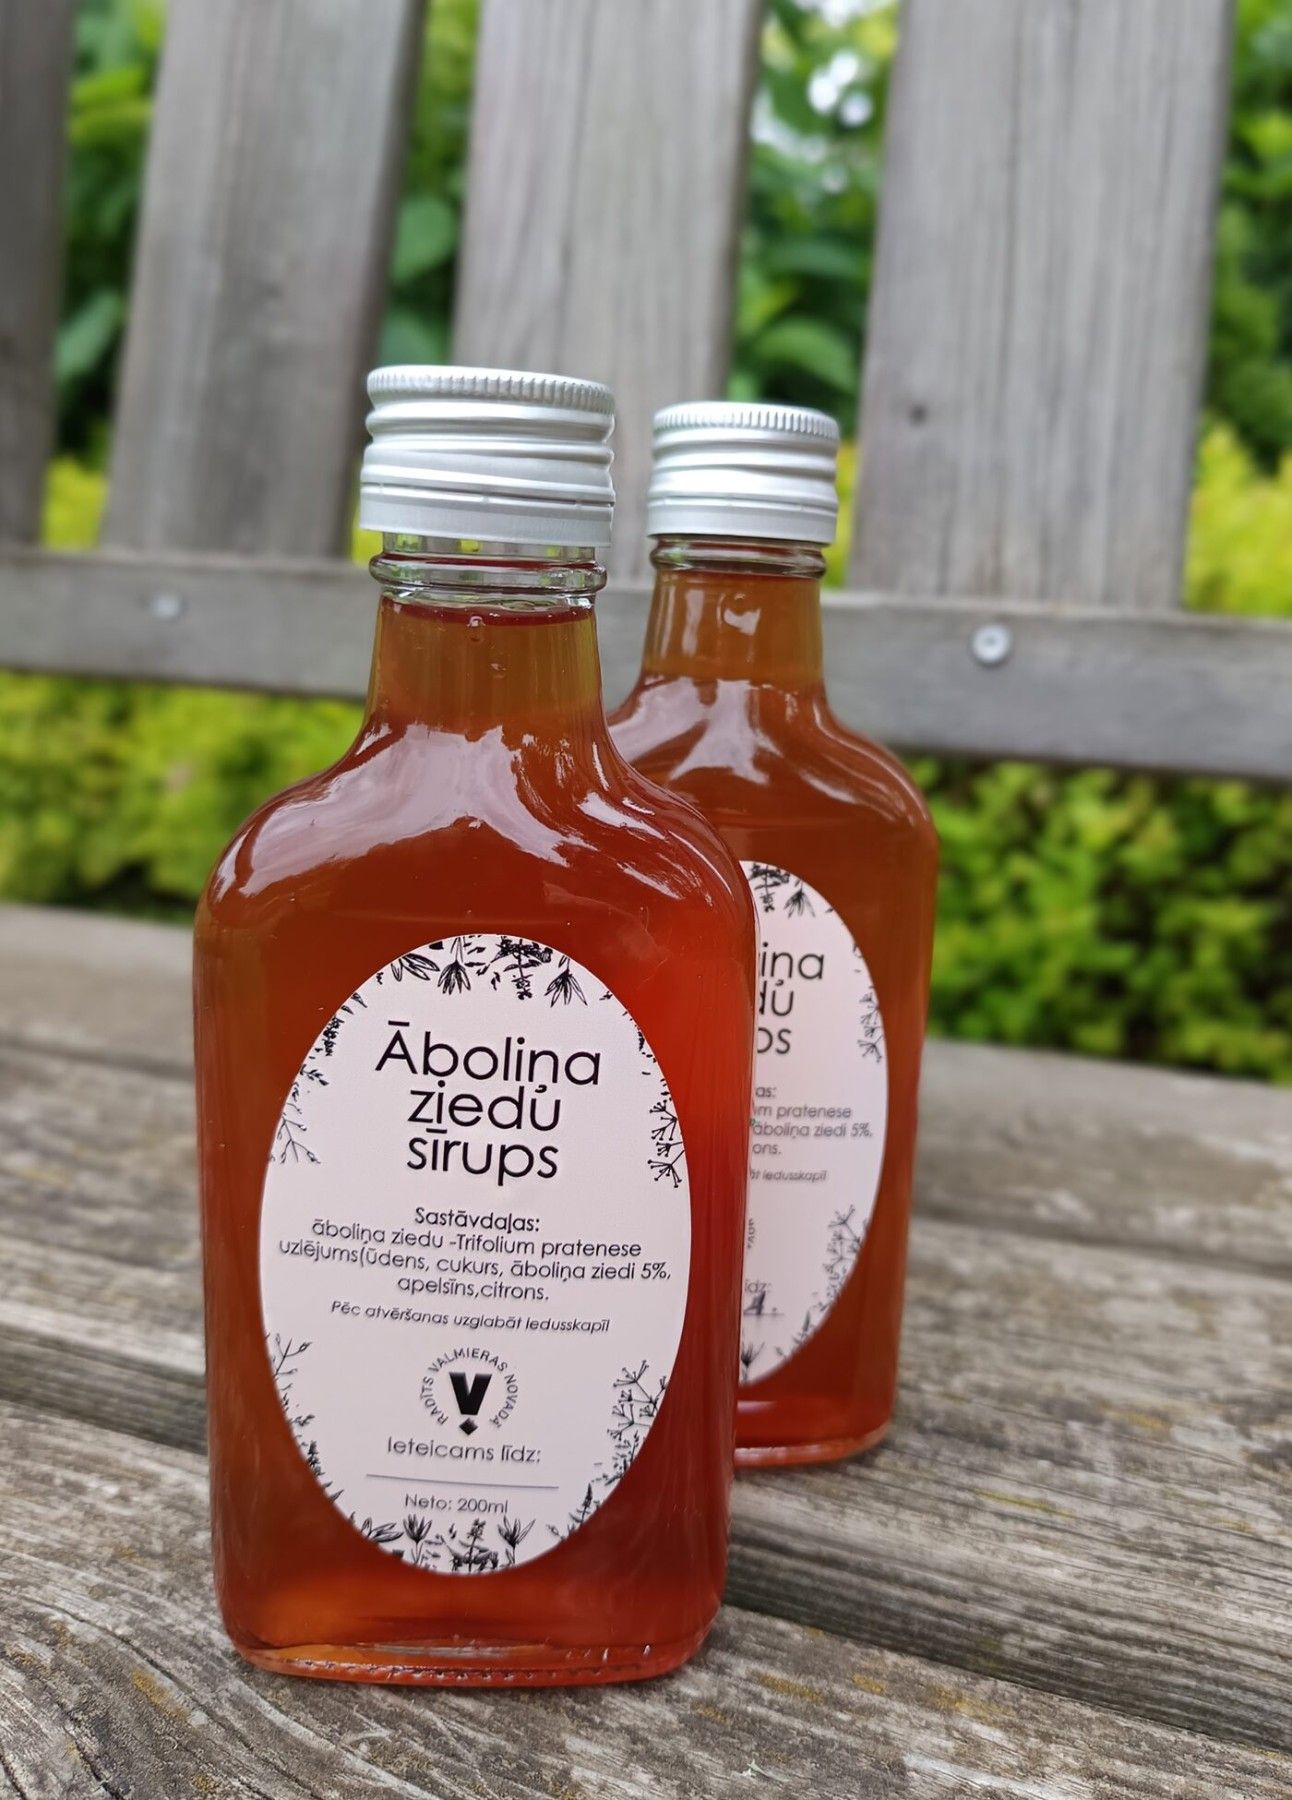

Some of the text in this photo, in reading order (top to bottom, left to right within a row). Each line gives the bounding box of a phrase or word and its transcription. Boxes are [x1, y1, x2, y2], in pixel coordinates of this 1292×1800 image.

[375, 1020, 601, 1093] Āboliņa
[406, 1128, 560, 1186] sīrups
[414, 1206, 540, 1234] Sastāvdaļas:
[312, 1218, 386, 1245] āboliņa
[391, 1228, 444, 1249] ziedu
[541, 1239, 642, 1259] pratenese
[436, 1256, 503, 1278] cukurs,
[510, 1259, 585, 1282] āboliņa
[591, 1261, 636, 1280] ziedi
[640, 1261, 672, 1280] 5%,
[331, 1300, 362, 1316] Pēc
[365, 1304, 449, 1325] atvēršanas
[453, 1314, 522, 1330] uzglabāt
[427, 1346, 508, 1373] VALMIERAS
[501, 1444, 541, 1463] līdz:
[404, 1492, 509, 1515] Neto: 200ml
